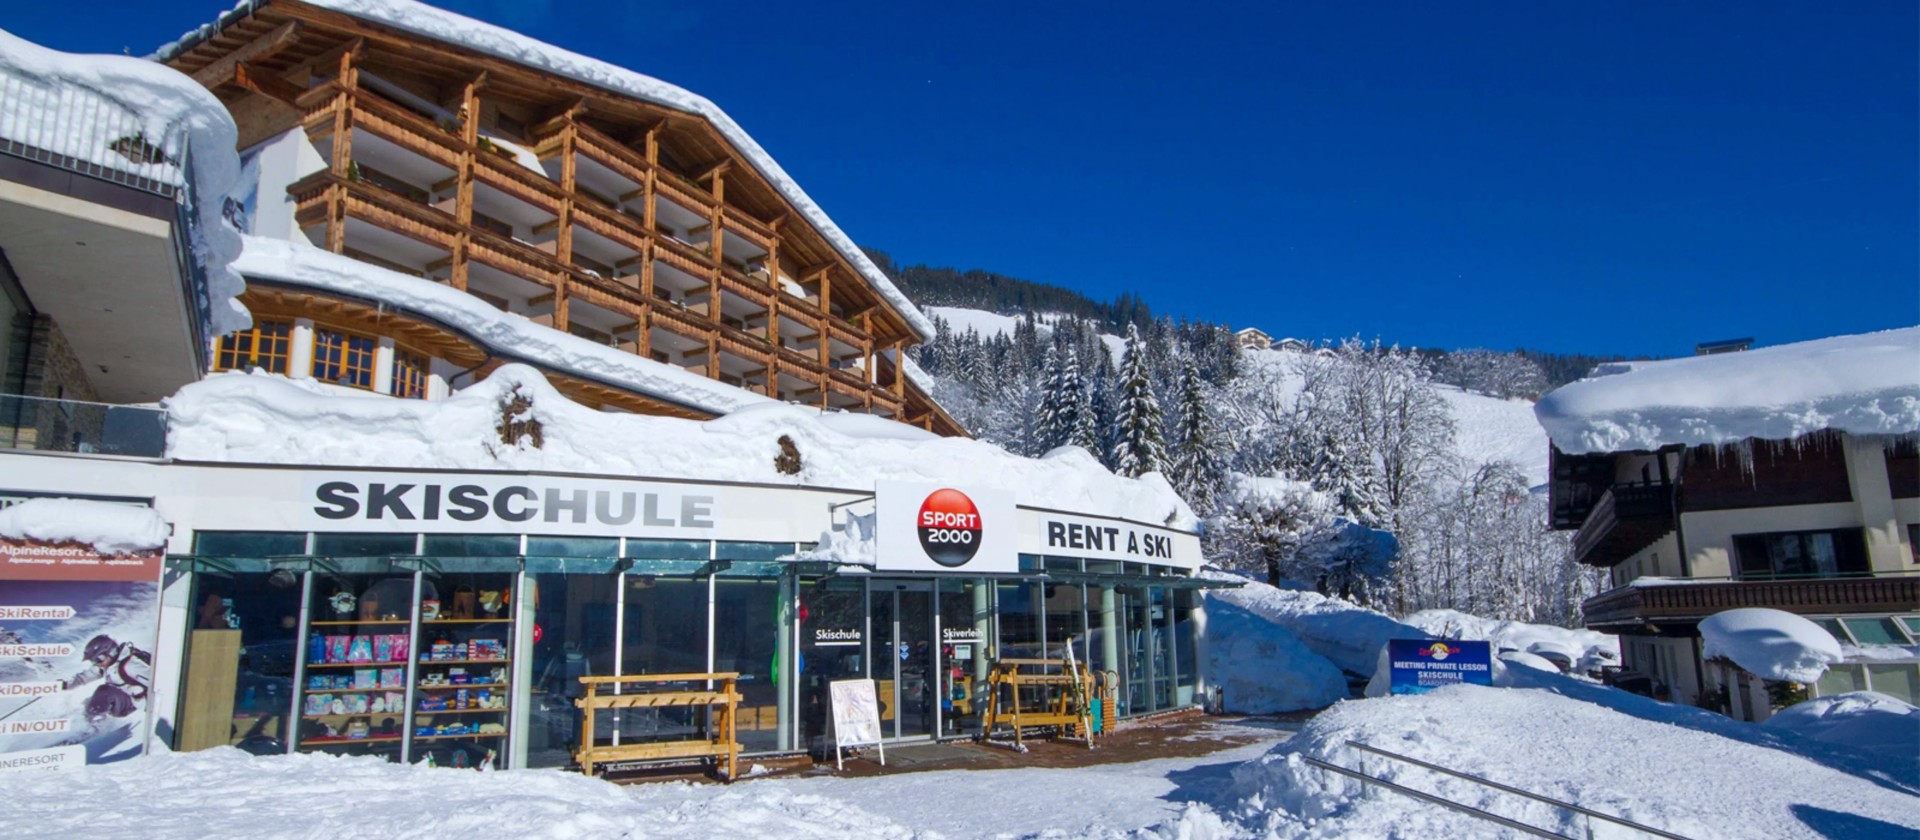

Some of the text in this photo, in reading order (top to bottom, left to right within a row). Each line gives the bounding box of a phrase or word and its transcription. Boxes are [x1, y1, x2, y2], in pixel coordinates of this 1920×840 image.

[313, 481, 714, 528] SKISCHULE
[922, 511, 977, 528] SPORT
[927, 528, 972, 544] 2000
[1048, 520, 1172, 559] RENT A SKI
[0, 544, 83, 558] AlpineResort
[0, 608, 70, 618] SkiRental
[816, 628, 861, 640] Skischule
[943, 628, 983, 638] Skiverleih
[0, 645, 70, 656] kiSchule
[1393, 661, 1488, 671] MEETING PRIVATE LESSON
[1418, 671, 1463, 680] SKISCHULE
[0, 684, 58, 696] kiDepot
[11, 720, 67, 733] IN/OUT
